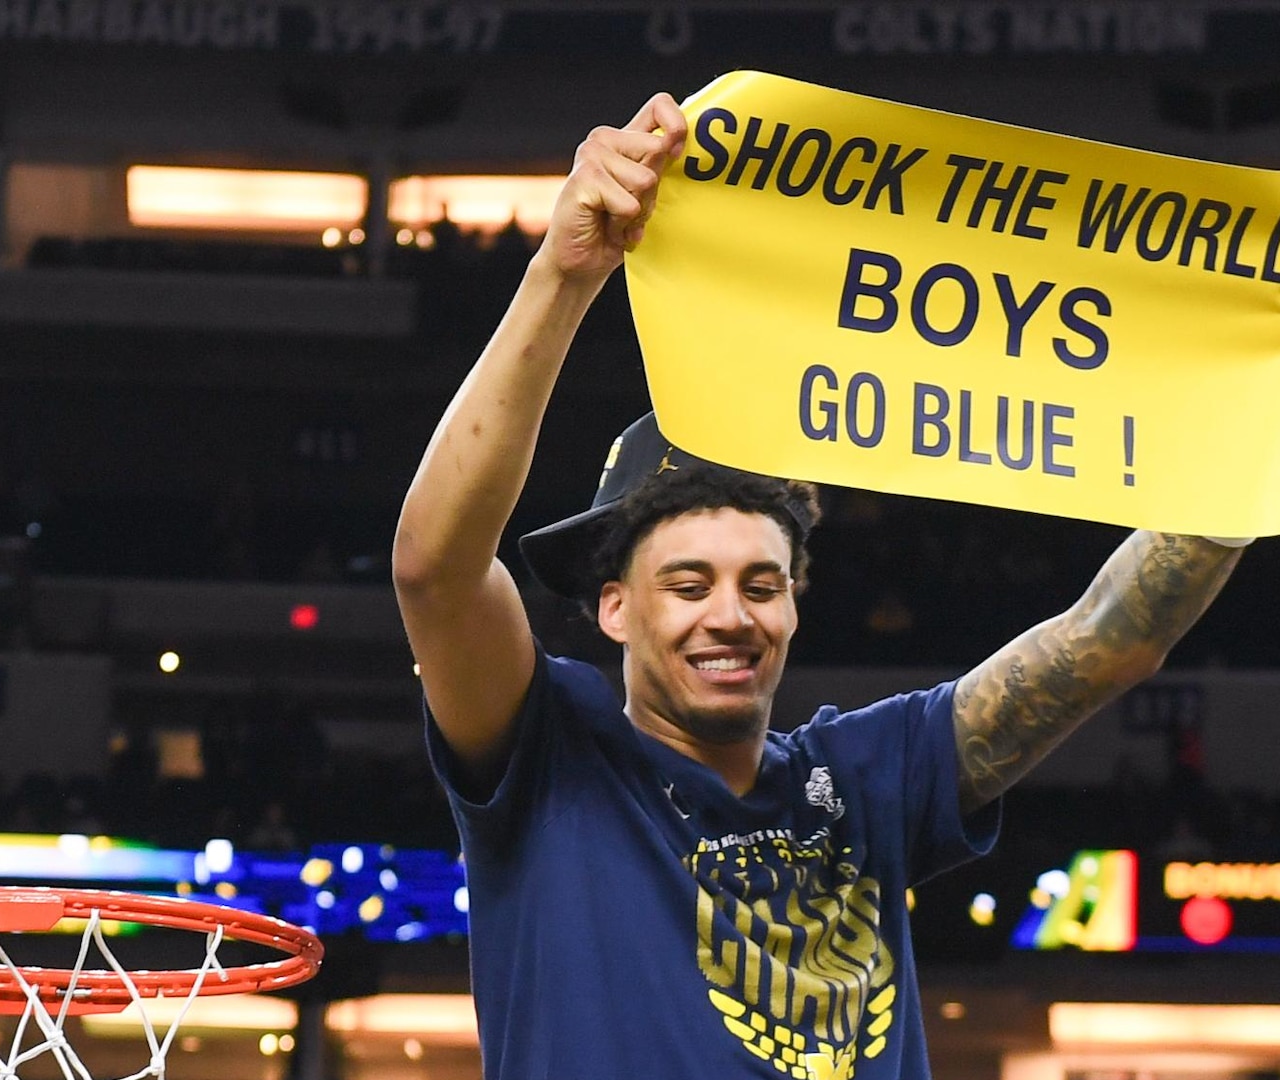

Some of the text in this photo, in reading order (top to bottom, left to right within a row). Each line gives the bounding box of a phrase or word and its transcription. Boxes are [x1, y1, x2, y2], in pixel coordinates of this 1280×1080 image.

[834, 0, 1206, 54] COLTS NATION
[683, 106, 929, 215] SHOCK
[935, 153, 1069, 241] THE
[837, 247, 1113, 371] BOYS
[799, 364, 1136, 487] GO BLUE !
